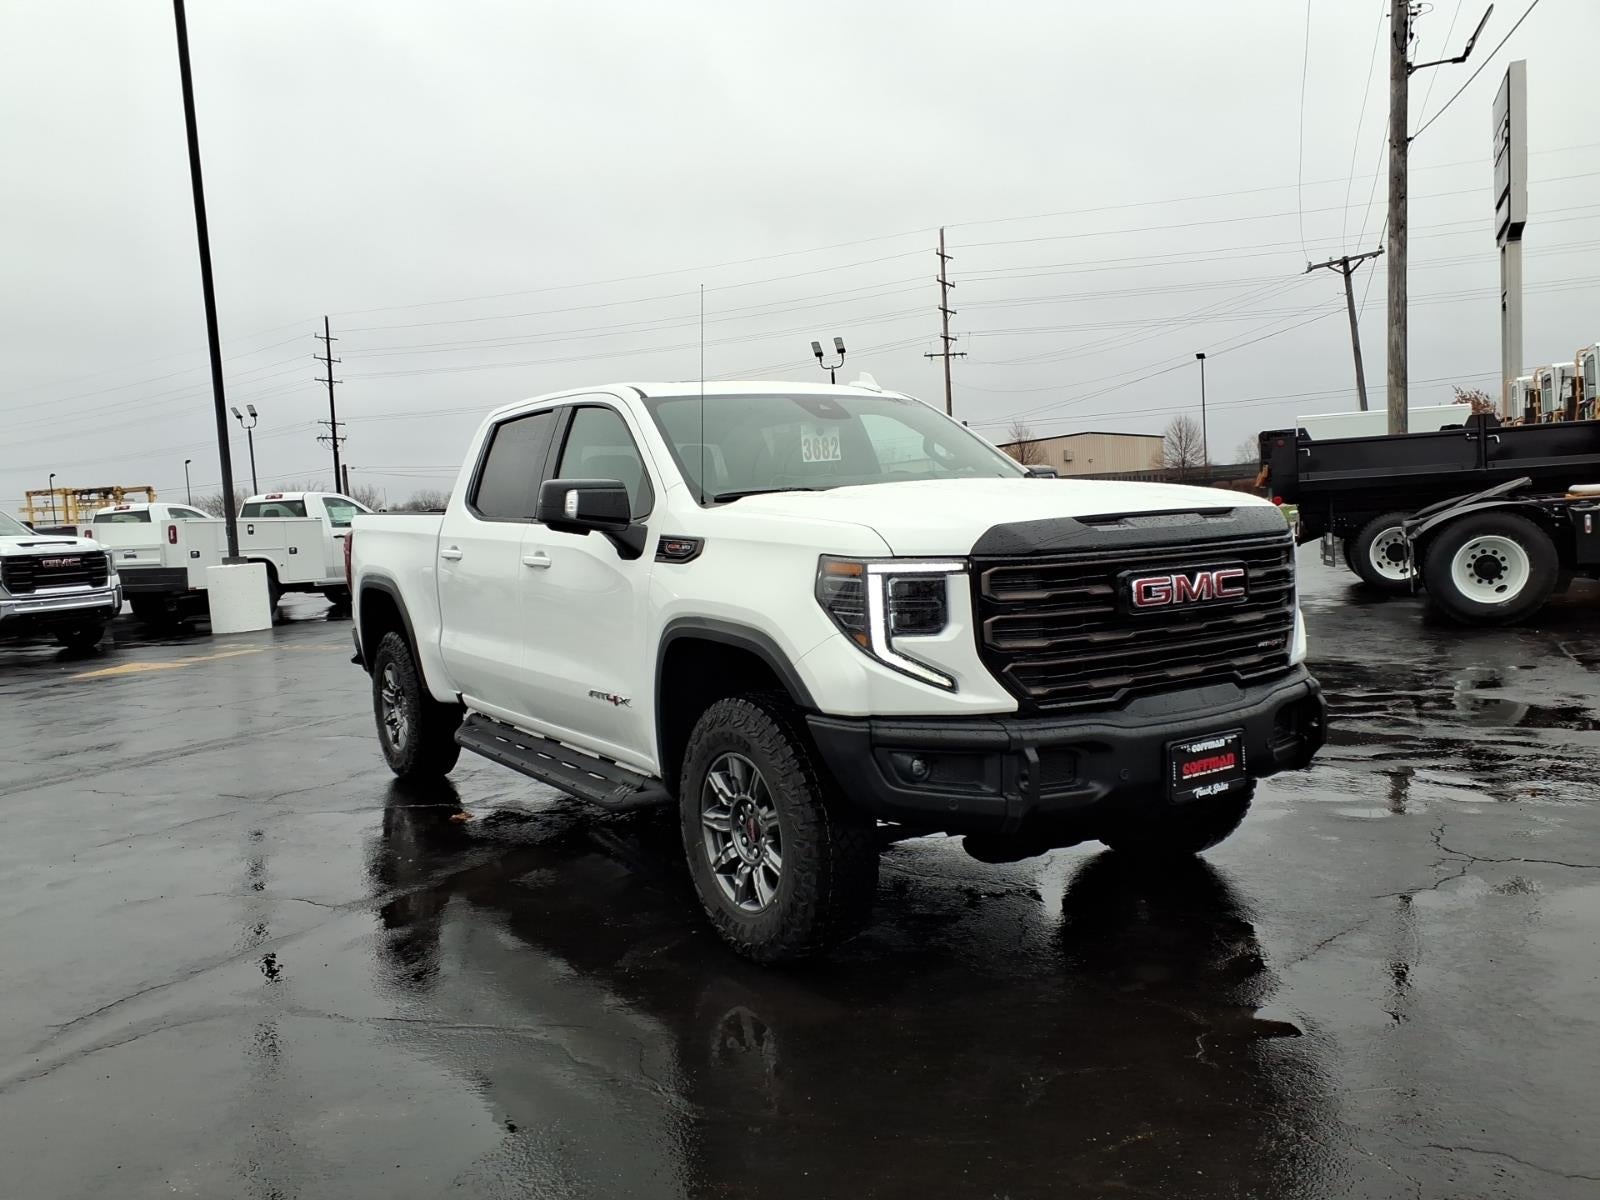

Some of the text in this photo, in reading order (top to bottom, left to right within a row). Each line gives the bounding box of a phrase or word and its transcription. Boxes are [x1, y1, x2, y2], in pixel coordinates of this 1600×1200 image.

[42, 558, 80, 568] GMC
[1132, 569, 1245, 607] GMC
[588, 690, 632, 708] AT4X
[1191, 739, 1225, 752] COFFMAN
[1182, 753, 1235, 774] COFFMAN
